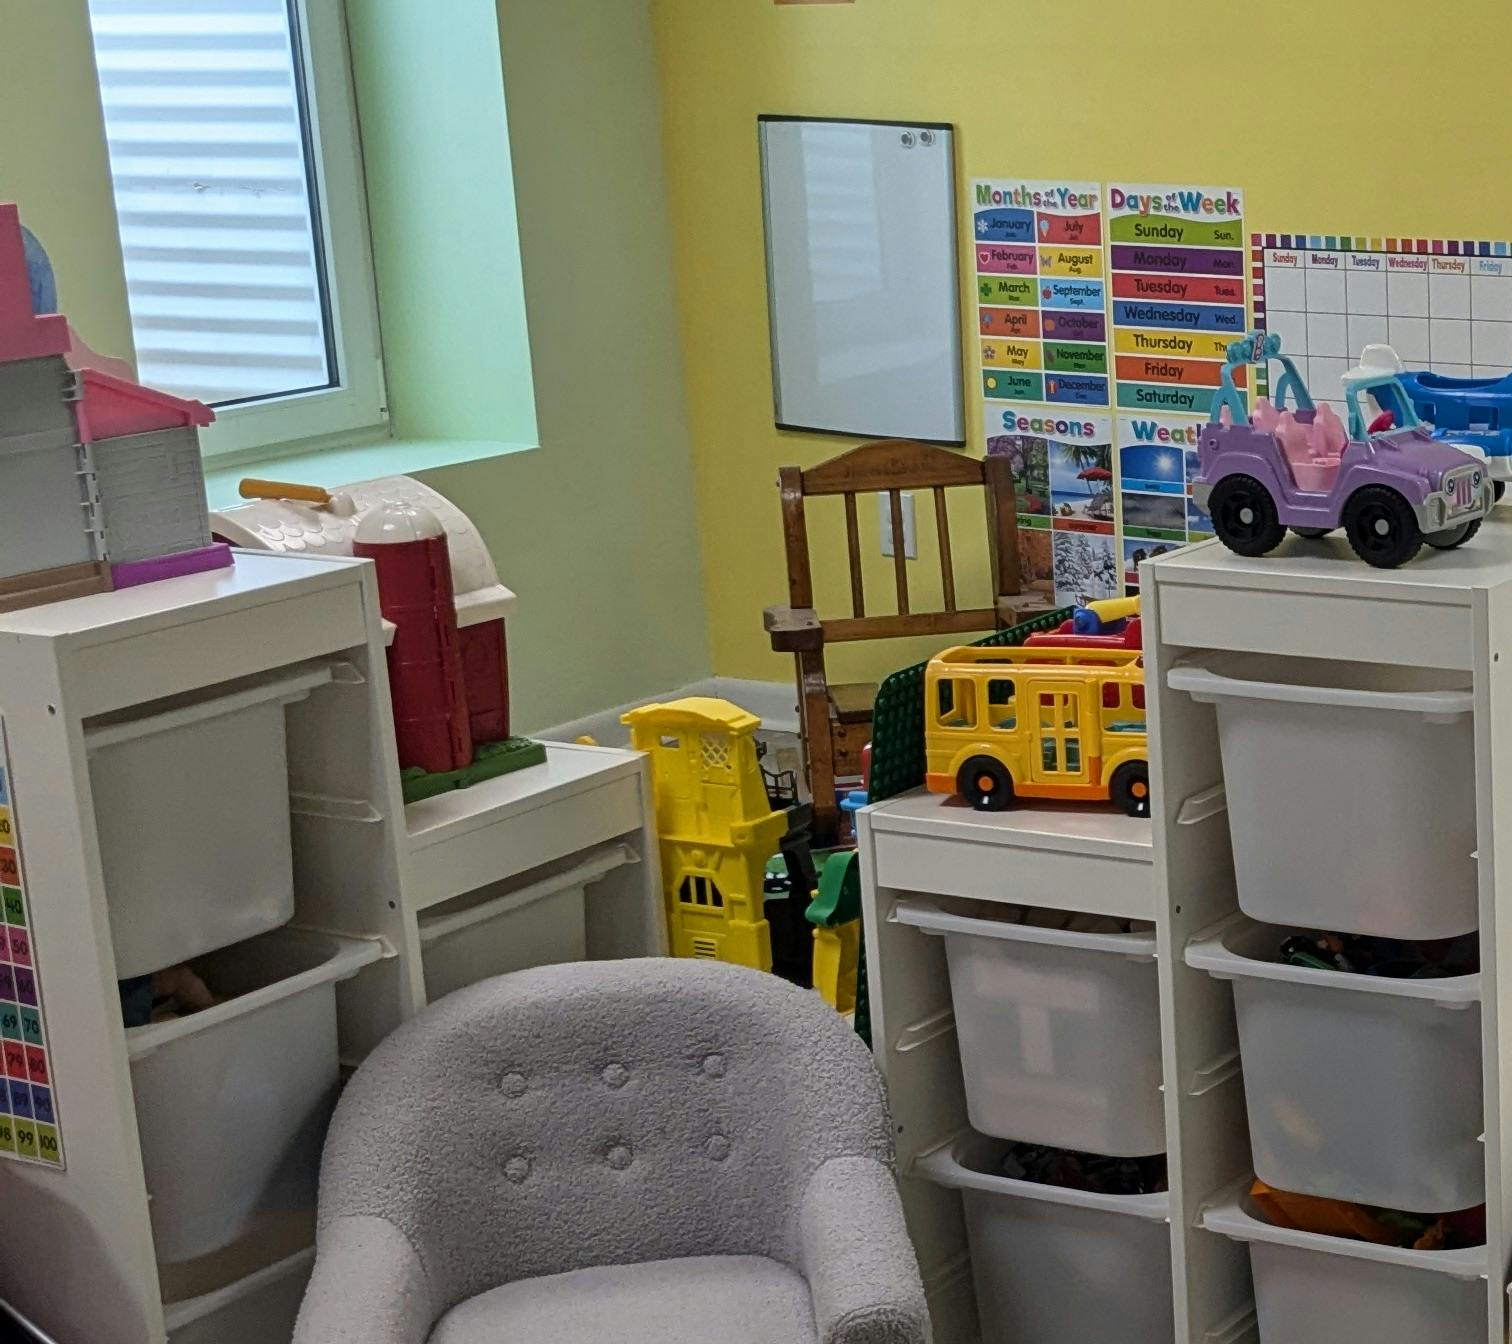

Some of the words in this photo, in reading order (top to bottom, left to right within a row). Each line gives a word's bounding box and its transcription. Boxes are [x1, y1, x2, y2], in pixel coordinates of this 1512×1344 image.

[976, 184, 1042, 207] Months
[1044, 188, 1054, 198] of
[1056, 187, 1099, 209] Year
[1165, 192, 1177, 203] of
[1042, 197, 1058, 207] the
[1110, 188, 1163, 216] Days
[1163, 202, 1180, 213] the
[1177, 191, 1241, 215] Week
[1063, 220, 1083, 235] July
[1134, 223, 1184, 242] Sunday
[1214, 230, 1234, 241] Sun.
[991, 249, 1034, 266] February
[1057, 252, 1093, 267] August
[1133, 251, 1187, 270] Monday
[1272, 252, 1298, 266] Sunday
[1311, 254, 1338, 268] Monday
[1351, 256, 1380, 270] Tuesday
[1388, 256, 1428, 271] Wednesday
[998, 281, 1031, 294] March
[1053, 283, 1101, 300] September
[1133, 278, 1188, 298] Tuesday
[1004, 313, 1027, 328] April
[1058, 316, 1099, 330] October
[1124, 305, 1200, 326] Wednesday
[1133, 333, 1192, 353] Thursday
[1006, 345, 1029, 360] May
[1057, 348, 1105, 362] November
[1144, 362, 1184, 380] Friday
[1007, 375, 1031, 388] June
[1058, 378, 1106, 392] December
[1136, 388, 1195, 407] Saturday
[1002, 410, 1095, 438] Seasons
[3, 1013, 17, 1028] 69
[24, 1017, 40, 1035] 70
[17, 1128, 34, 1146] 99
[39, 1132, 58, 1152] 100
